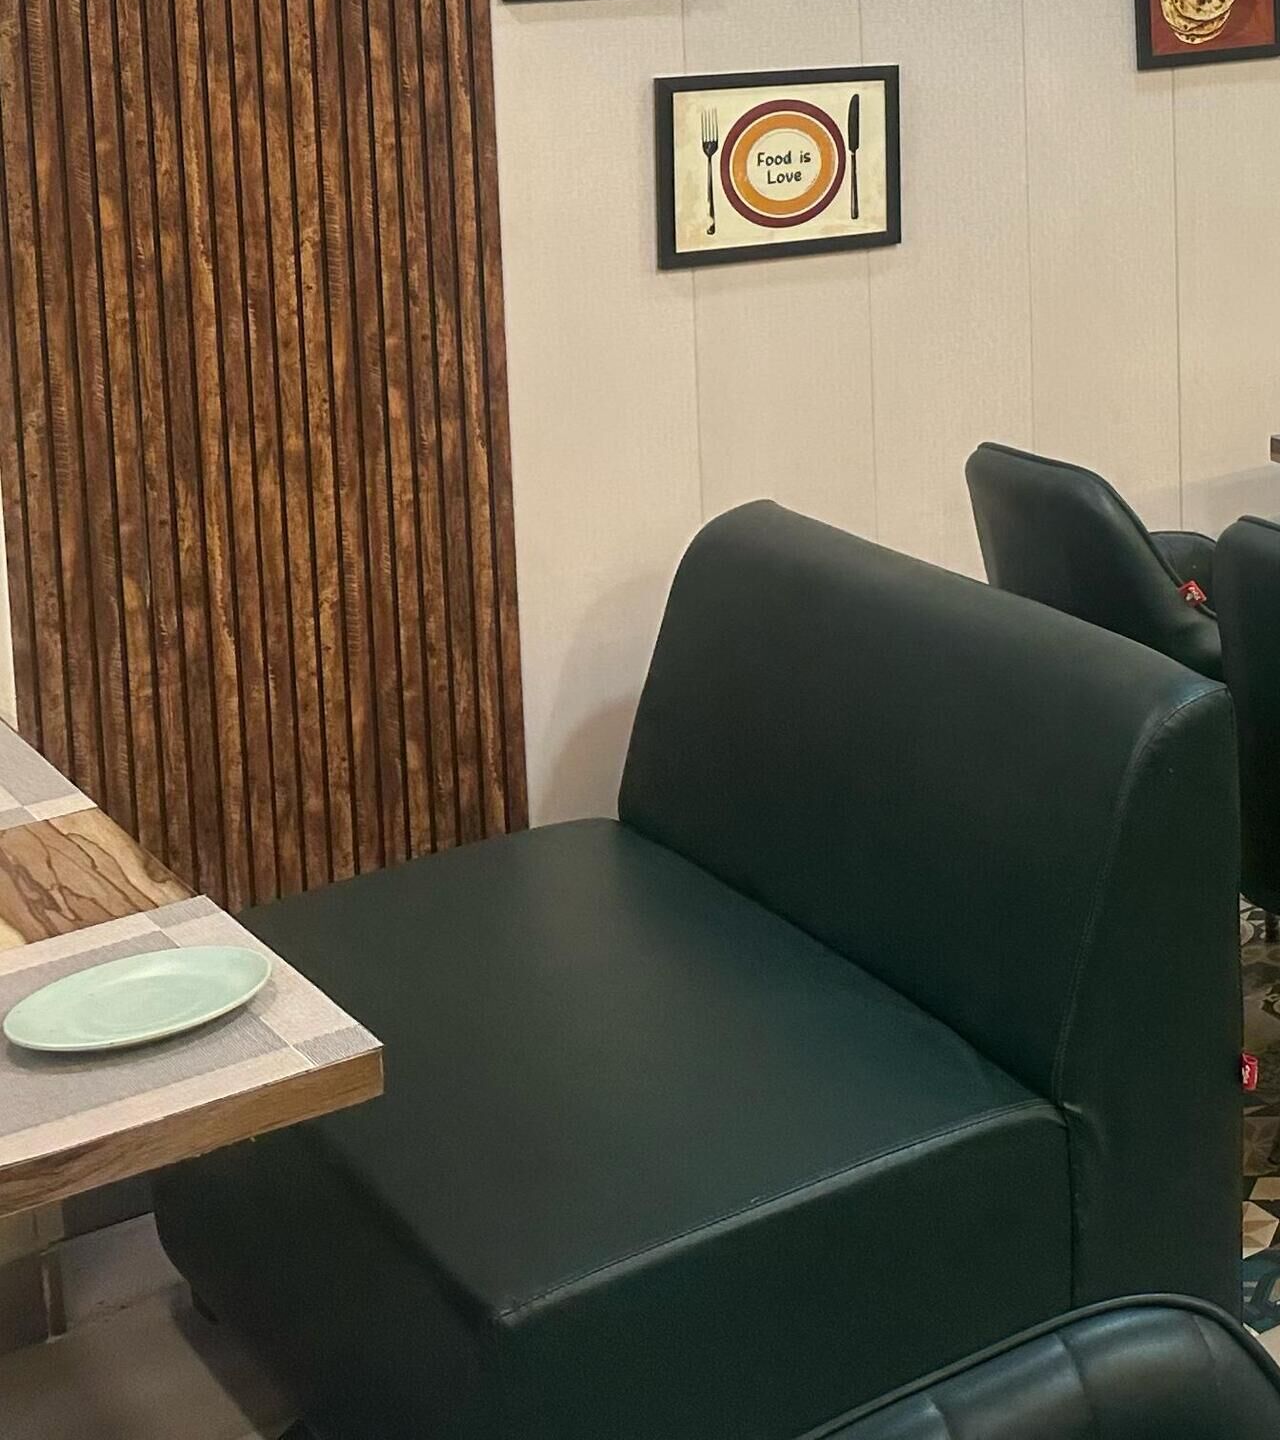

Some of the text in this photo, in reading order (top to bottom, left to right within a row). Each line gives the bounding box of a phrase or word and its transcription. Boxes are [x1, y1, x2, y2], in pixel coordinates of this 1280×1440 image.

[757, 150, 812, 167] Food is
[767, 170, 802, 185] Love
